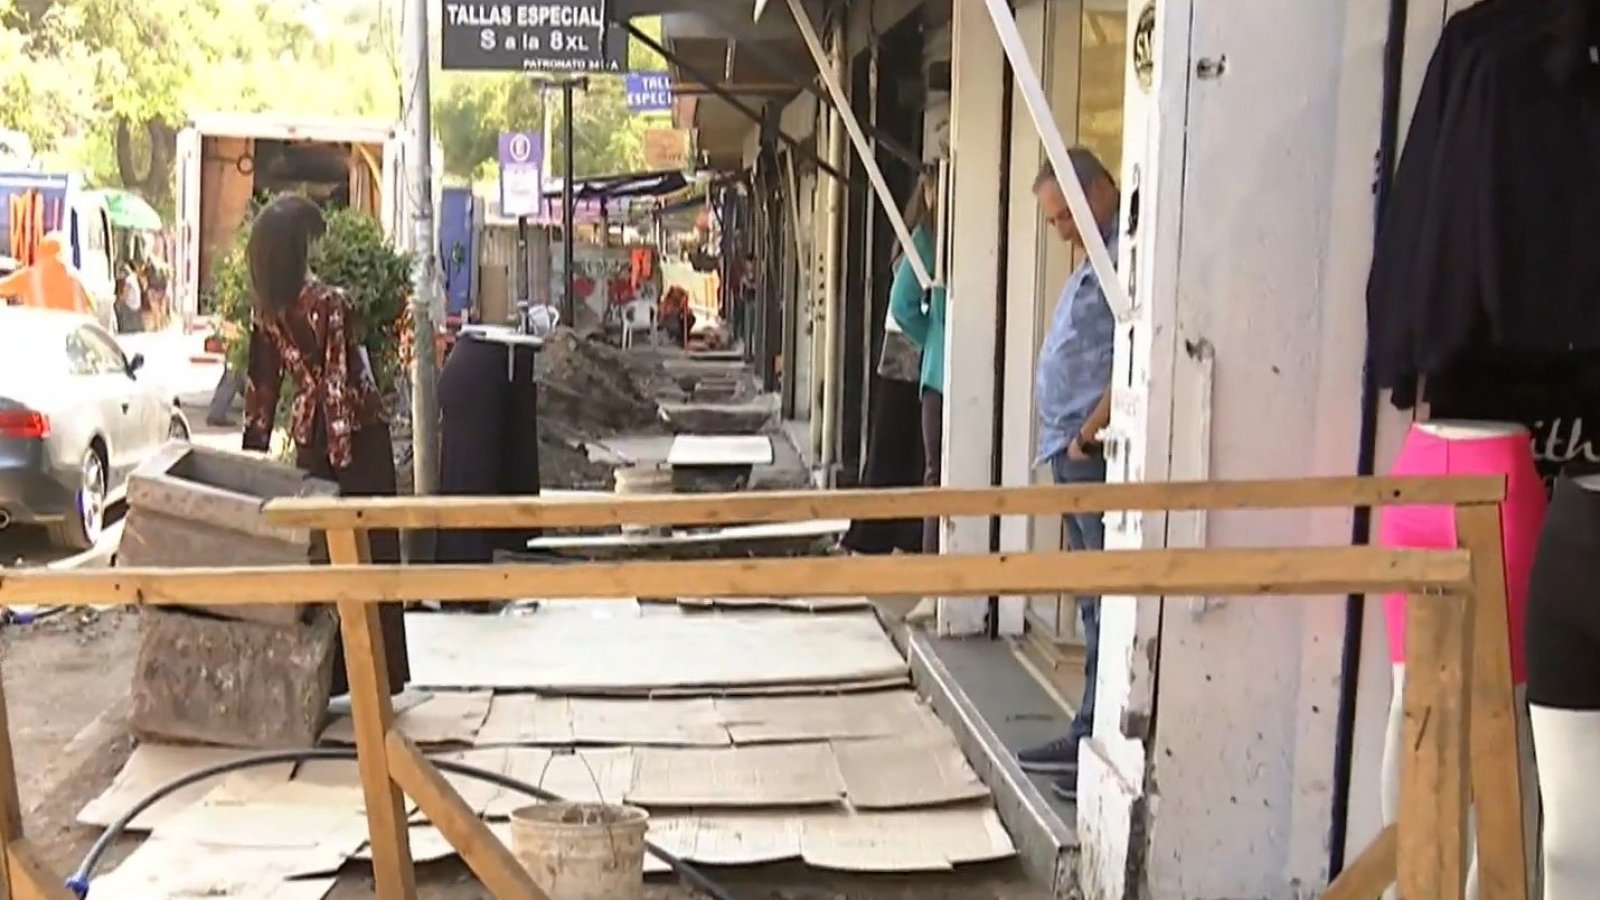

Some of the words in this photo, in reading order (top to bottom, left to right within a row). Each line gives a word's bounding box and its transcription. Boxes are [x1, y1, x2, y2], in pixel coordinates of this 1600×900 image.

[447, 5, 513, 26] TALLAS
[480, 28, 497, 50] S
[504, 36, 517, 50] a
[522, 33, 540, 50] la
